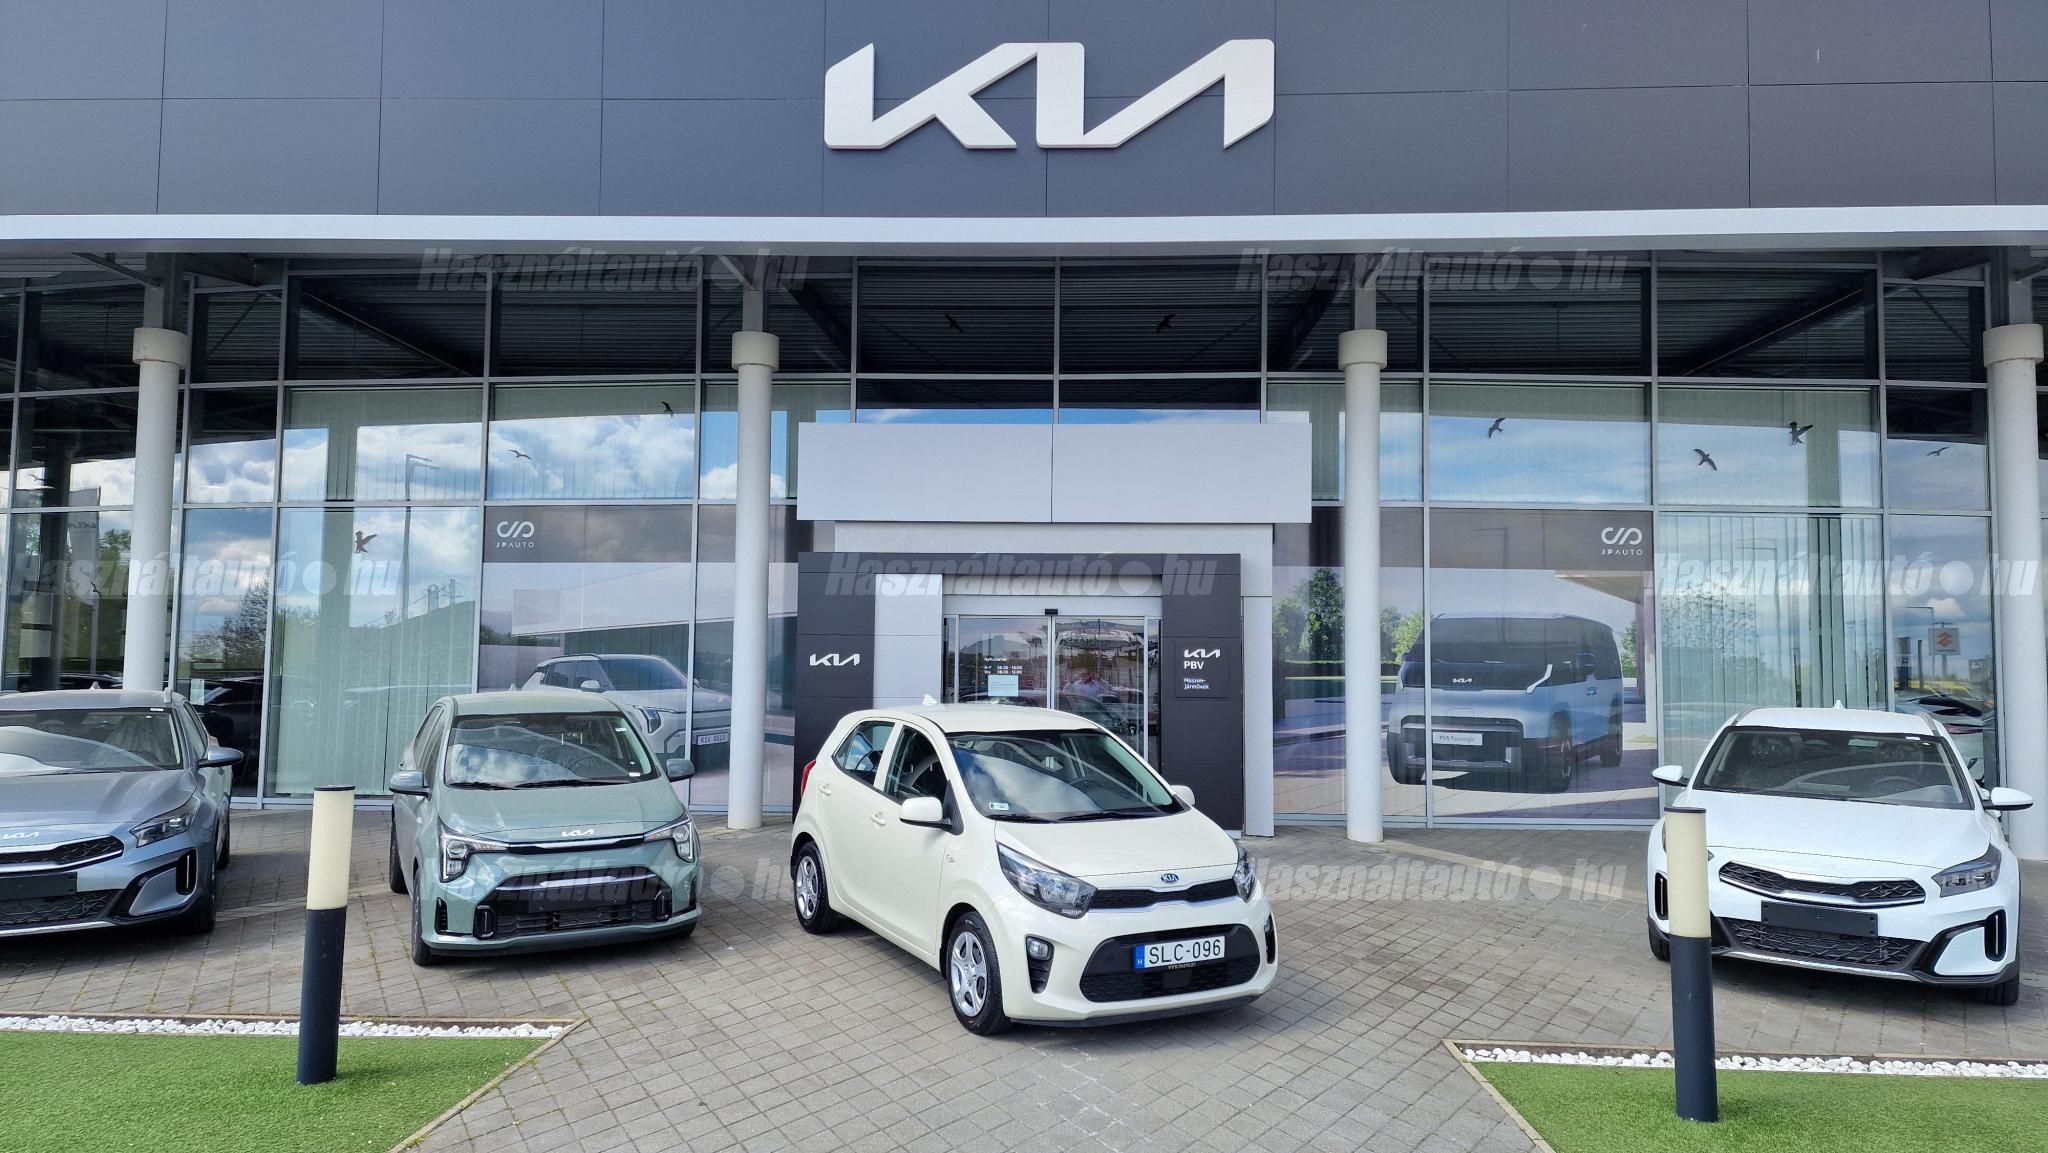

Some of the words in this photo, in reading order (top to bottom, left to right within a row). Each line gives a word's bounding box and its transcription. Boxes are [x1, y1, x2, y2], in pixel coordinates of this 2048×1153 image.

[824, 38, 1275, 149] KIA
[1183, 648, 1221, 658] KIA
[809, 653, 861, 666] KIA
[1183, 660, 1205, 670] PBV
[3, 831, 40, 840] KIA
[561, 828, 595, 837] KIA
[1163, 873, 1178, 883] KIA
[1148, 939, 1222, 965] SLC-096
